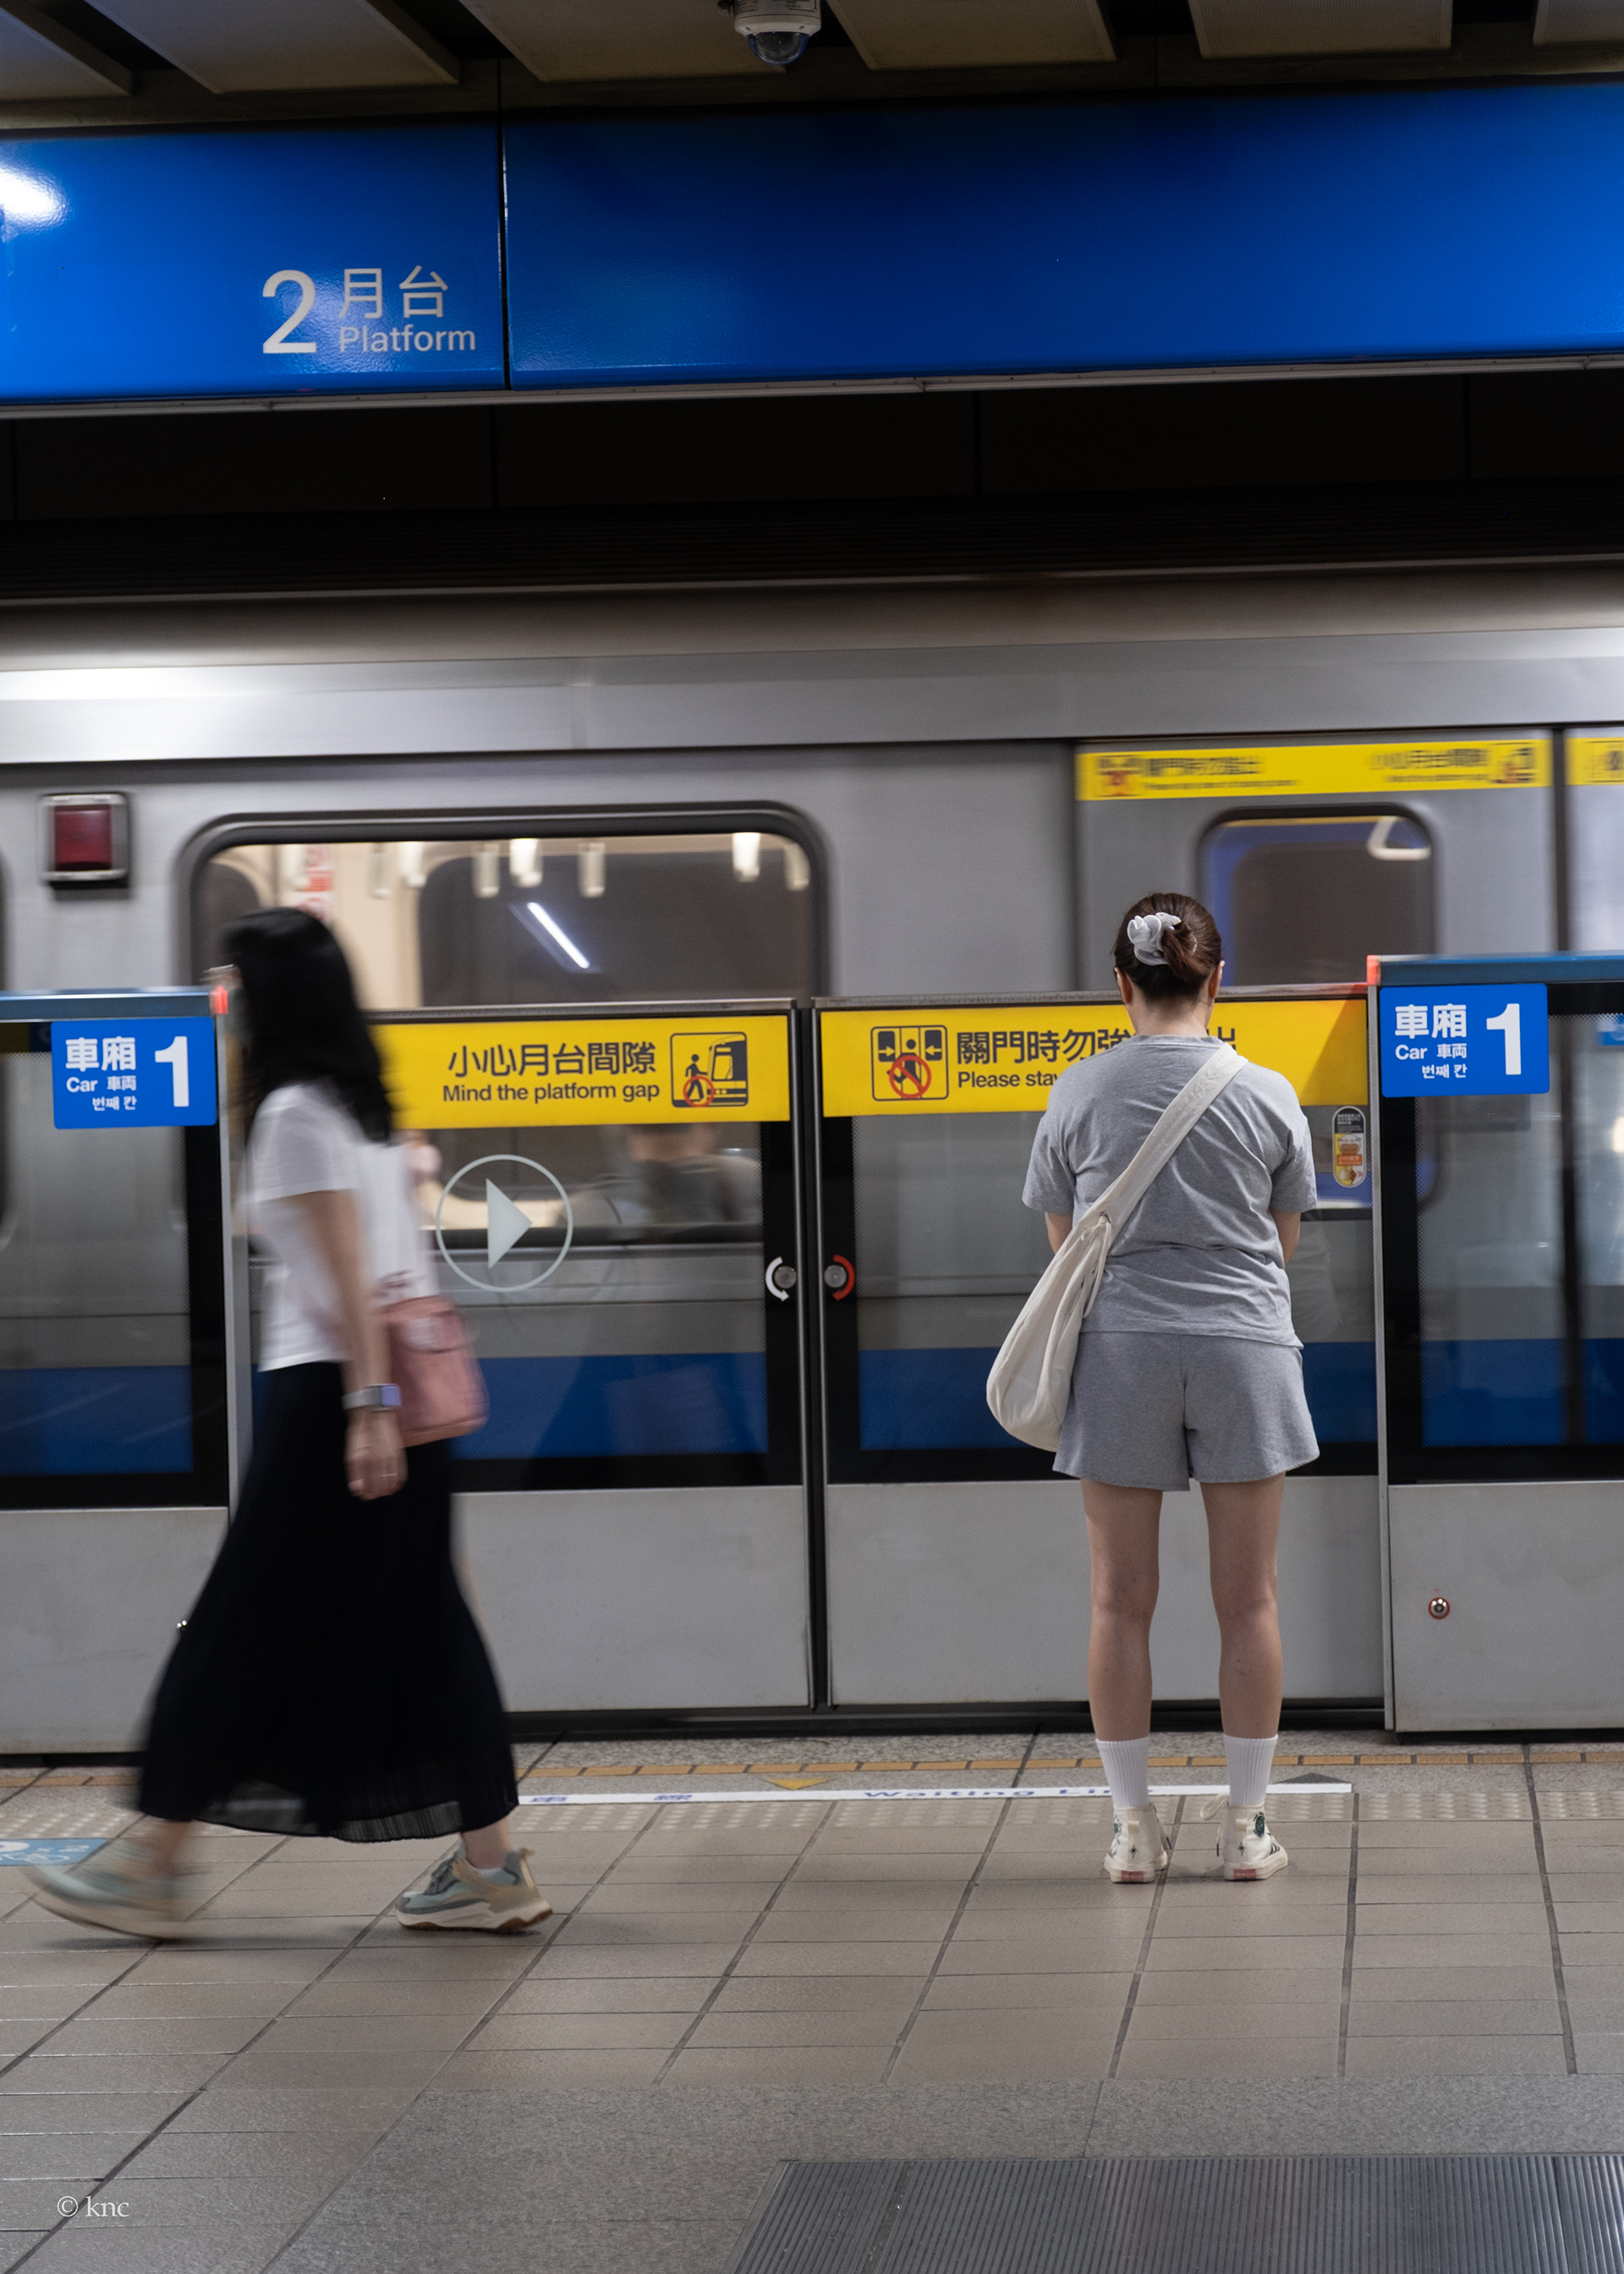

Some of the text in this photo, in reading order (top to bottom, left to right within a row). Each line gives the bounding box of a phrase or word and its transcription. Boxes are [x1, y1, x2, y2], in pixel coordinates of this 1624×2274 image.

[338, 265, 448, 319] 月台
[261, 269, 317, 354] 2
[340, 324, 476, 353] Platform
[1395, 1003, 1468, 1039] 車廂
[65, 1035, 136, 1072] 車廂
[1395, 1044, 1428, 1060] Car
[1486, 1002, 1522, 1075] 1
[154, 1035, 189, 1107] 1
[447, 1041, 656, 1078] 小心月台間隙
[1421, 1063, 1468, 1079] 번째 칸
[66, 1076, 98, 1093] Car
[443, 1082, 660, 1104] Mind the platform gap
[957, 1071, 1020, 1088] Please
[92, 1096, 137, 1111] 번째 칸
